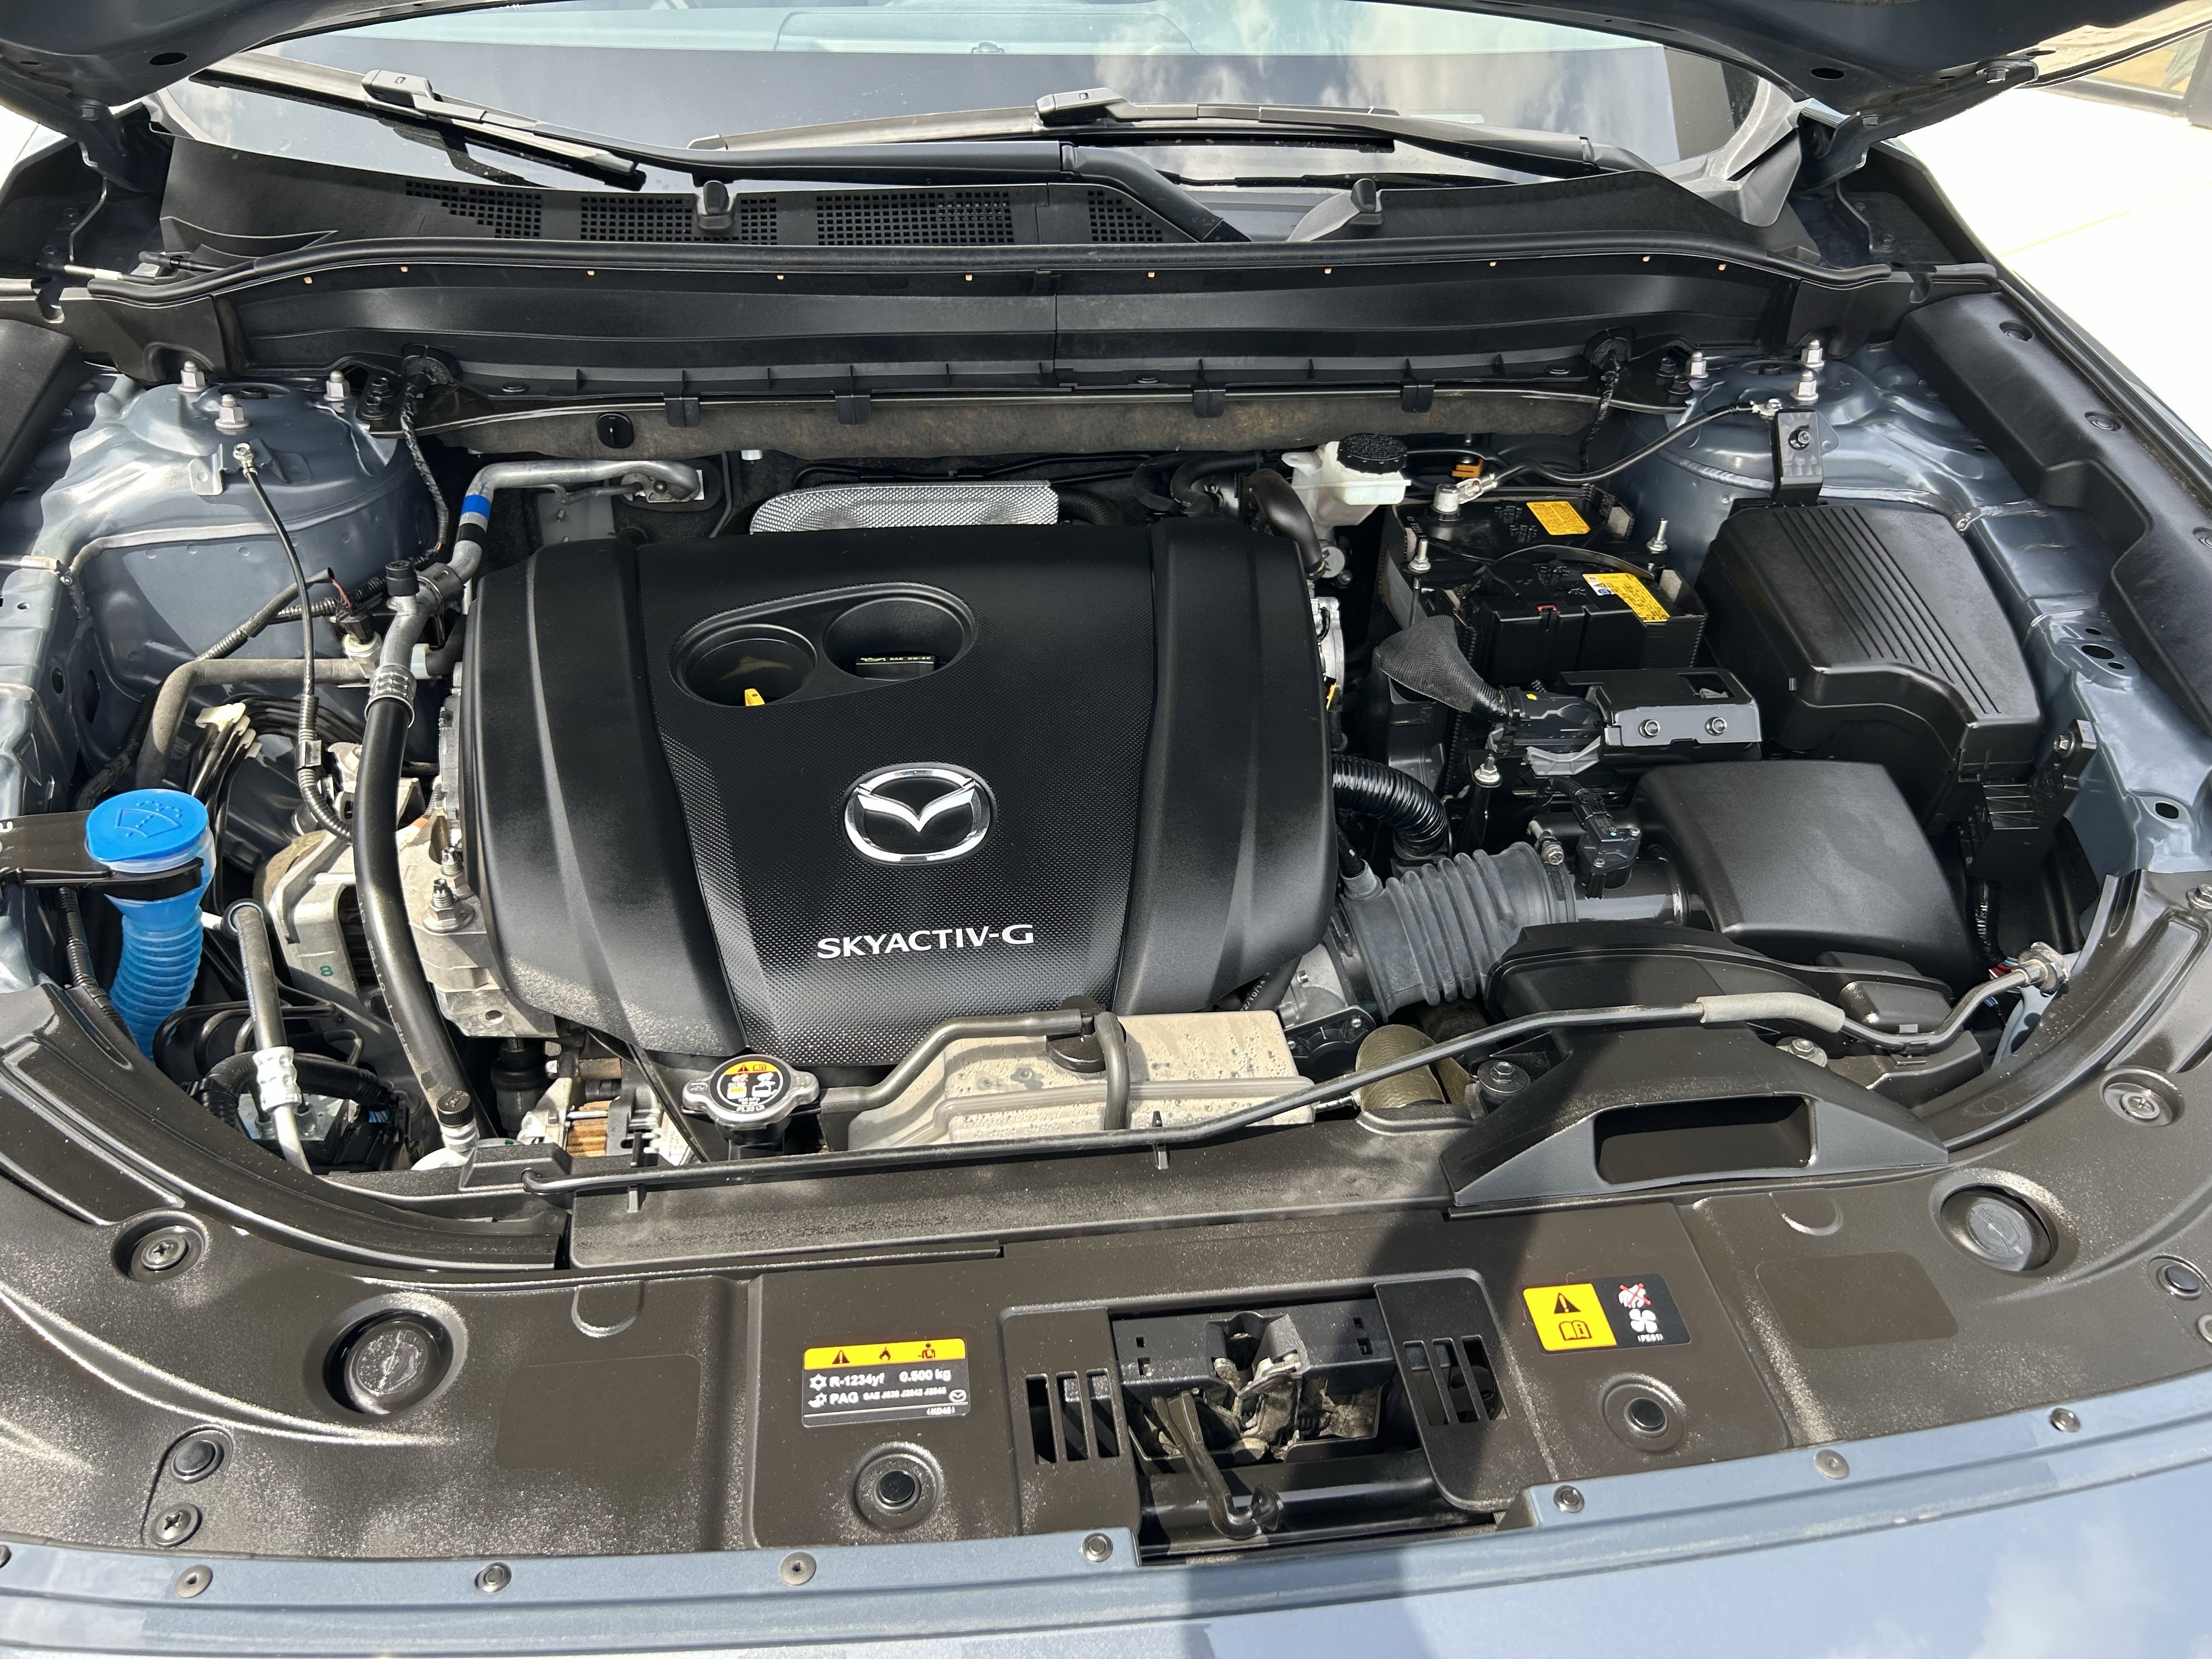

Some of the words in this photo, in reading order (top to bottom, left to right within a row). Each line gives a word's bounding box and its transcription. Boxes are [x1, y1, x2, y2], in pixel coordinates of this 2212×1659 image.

[817, 924, 1035, 959] SKYACTIV-G
[829, 1372, 885, 1387] R-1234yf
[899, 1369, 933, 1383] 0.500
[934, 1368, 951, 1381] kg
[829, 1391, 859, 1404] PAG
